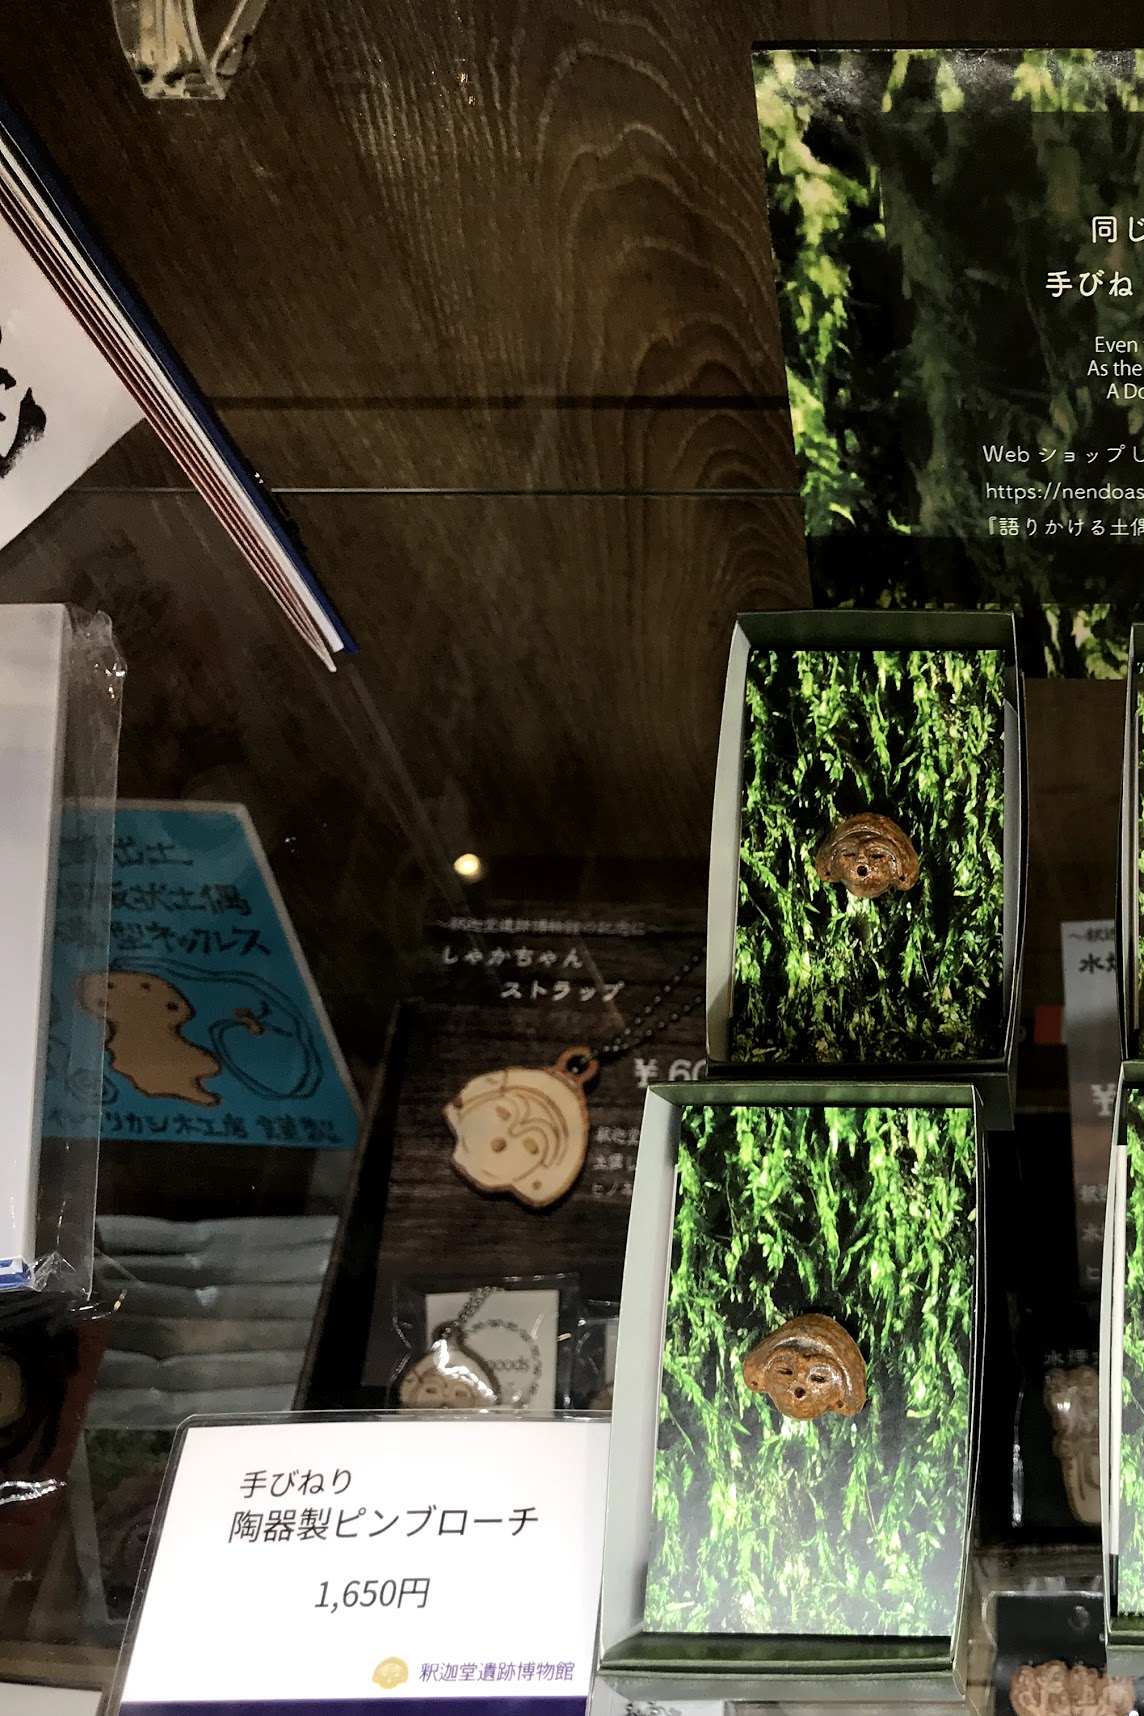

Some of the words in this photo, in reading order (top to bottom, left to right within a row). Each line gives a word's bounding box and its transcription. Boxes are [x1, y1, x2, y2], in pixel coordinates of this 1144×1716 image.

[1095, 336, 1138, 354] Even
[1087, 359, 1109, 377] As
[1112, 359, 1143, 377] the
[1106, 382, 1120, 399] A
[443, 946, 583, 968] しゃかちゃん
[500, 980, 625, 1002] ストラップ
[239, 1467, 353, 1499] 手びねり
[228, 1504, 539, 1544] 陶器製ピンブローチ
[314, 1576, 431, 1614] 1,650円
[419, 1661, 576, 1682] 釈迦堂遺跡博物館
